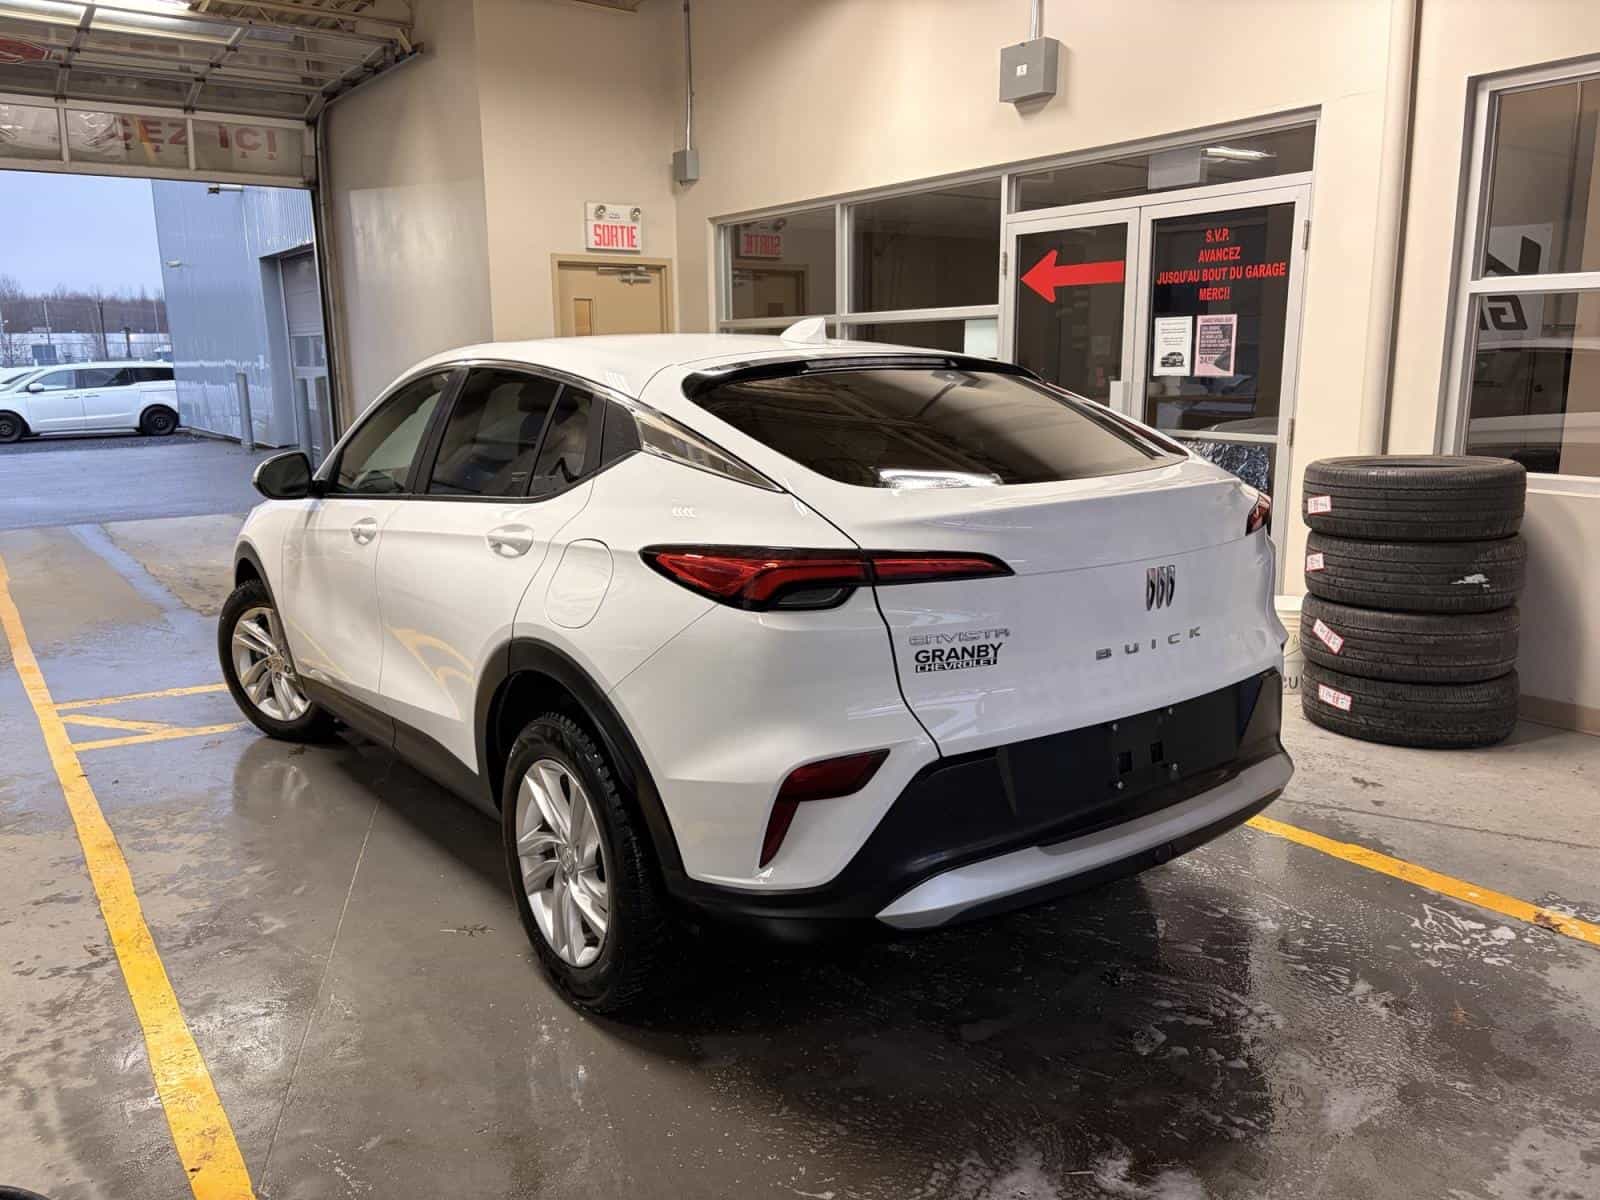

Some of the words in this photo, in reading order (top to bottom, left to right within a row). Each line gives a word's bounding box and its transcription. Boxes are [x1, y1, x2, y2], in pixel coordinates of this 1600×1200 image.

[593, 223, 637, 248] SORTIE
[1206, 228, 1229, 242] S.V.P.
[1199, 246, 1241, 262] AVANCEZ
[1156, 270, 1200, 285] JUSQU'AU
[1202, 267, 1228, 281] BOUT
[1229, 265, 1243, 279] DU
[1245, 262, 1286, 279] GARAGE
[914, 642, 1003, 664] GRANBY
[1095, 625, 1202, 661] BUICK
[915, 658, 998, 673] CHEVROLET
